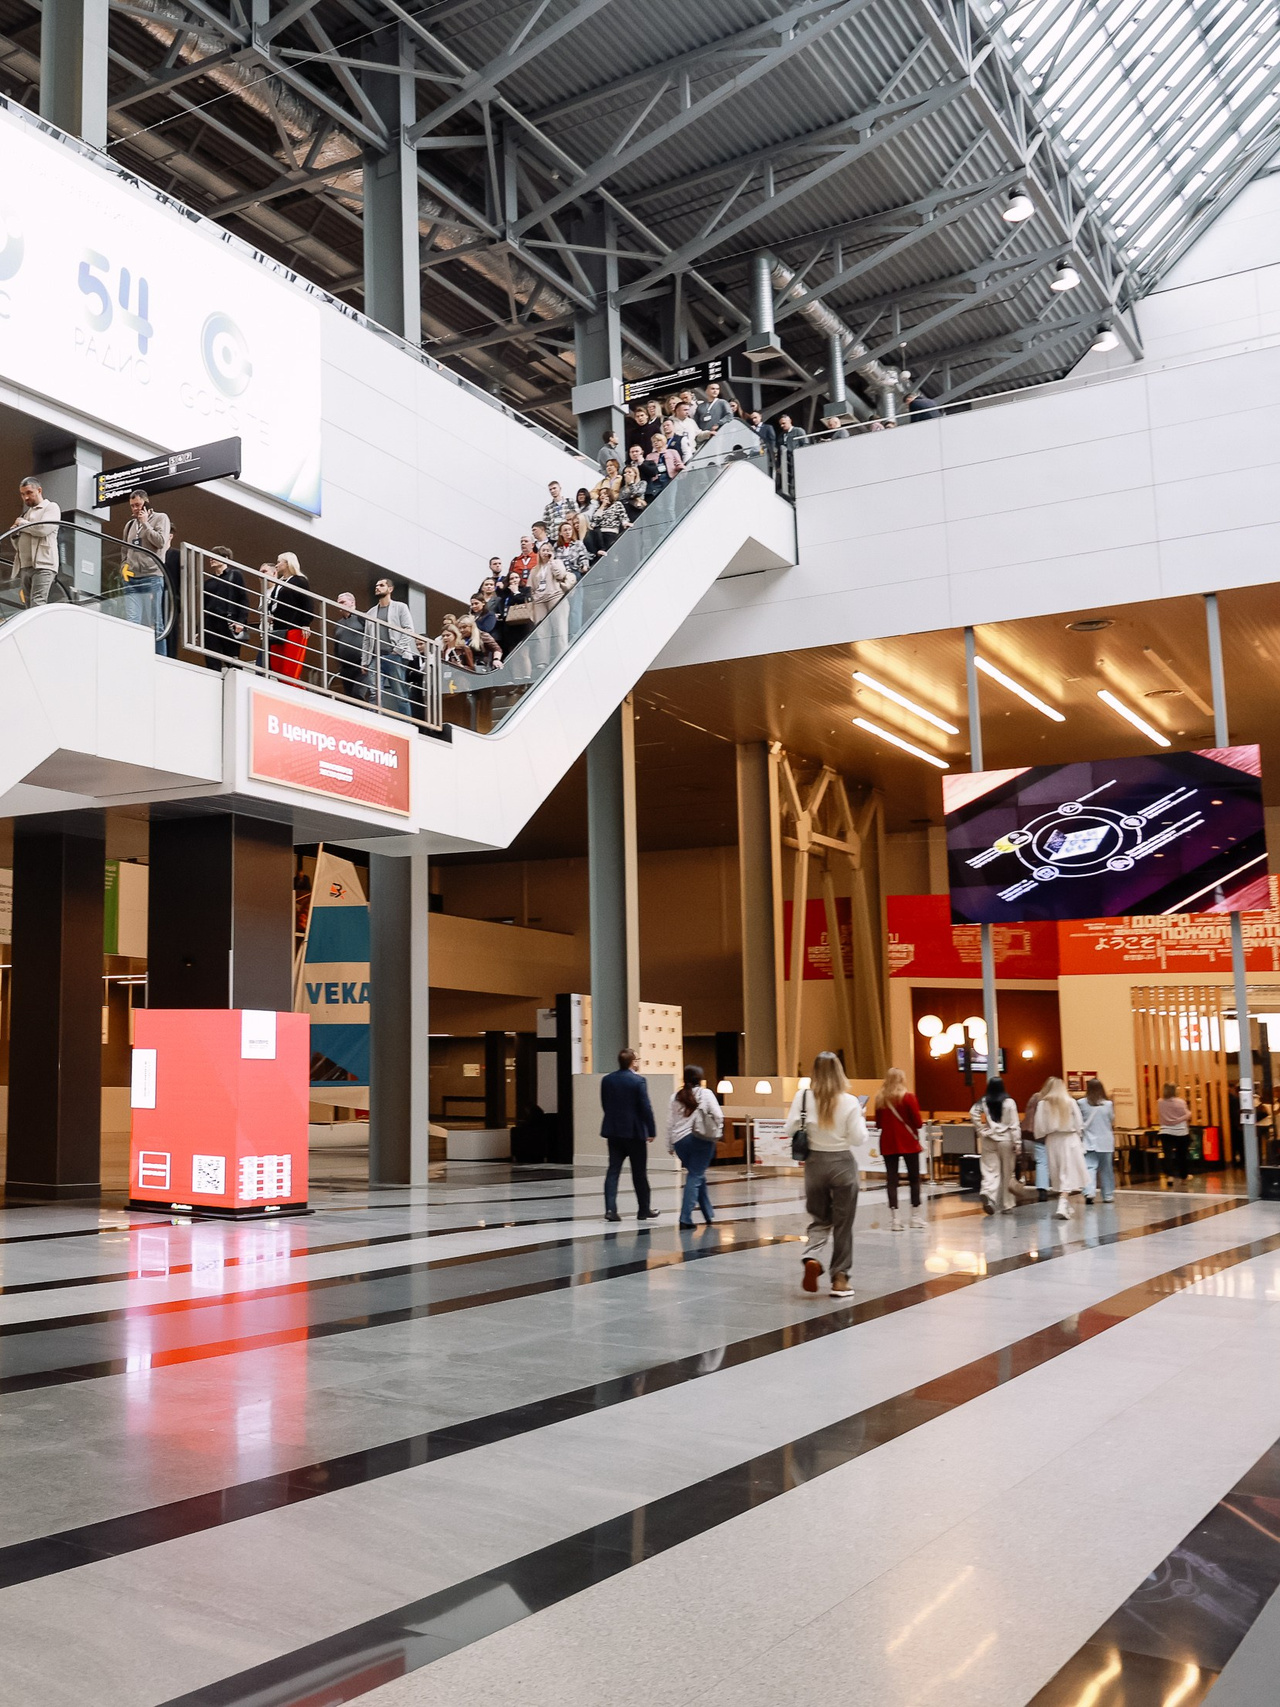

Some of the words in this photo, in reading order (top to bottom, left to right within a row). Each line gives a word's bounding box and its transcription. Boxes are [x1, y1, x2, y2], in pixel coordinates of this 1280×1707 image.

[77, 247, 154, 357] 54
[267, 714, 279, 734] В
[282, 722, 336, 751] центре
[338, 739, 399, 769] событий
[1131, 913, 1191, 928] ДОБРО
[1094, 936, 1156, 951] ようこそ
[306, 982, 371, 1004] VEKA
